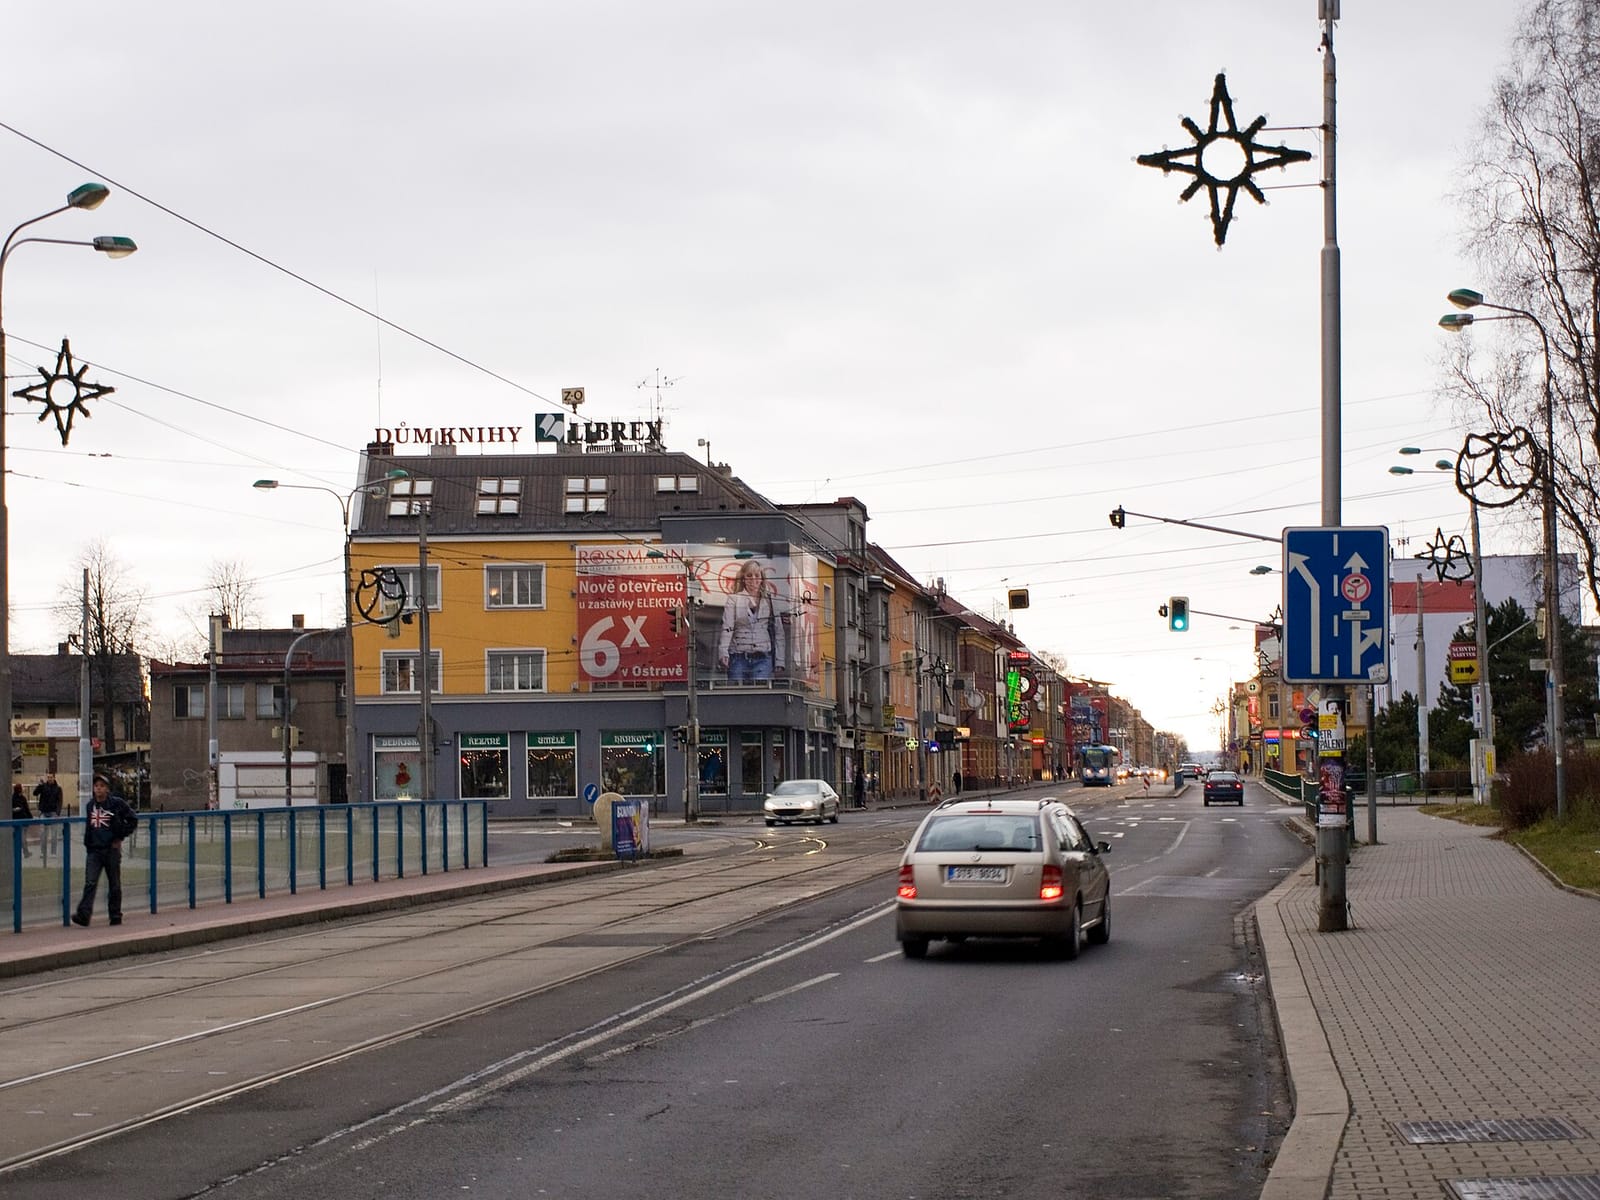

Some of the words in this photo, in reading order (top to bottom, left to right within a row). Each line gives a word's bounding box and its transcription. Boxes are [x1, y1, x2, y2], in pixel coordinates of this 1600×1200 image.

[375, 421, 433, 443] DŮM
[440, 427, 522, 443] KNIHY
[568, 421, 660, 442] LIBREX
[580, 580, 615, 594] Nově
[619, 579, 683, 593] otevřeno
[588, 598, 634, 612] zastávky
[637, 598, 684, 608] ELEKTRA
[622, 669, 629, 677] v
[632, 665, 683, 677] Ostravě
